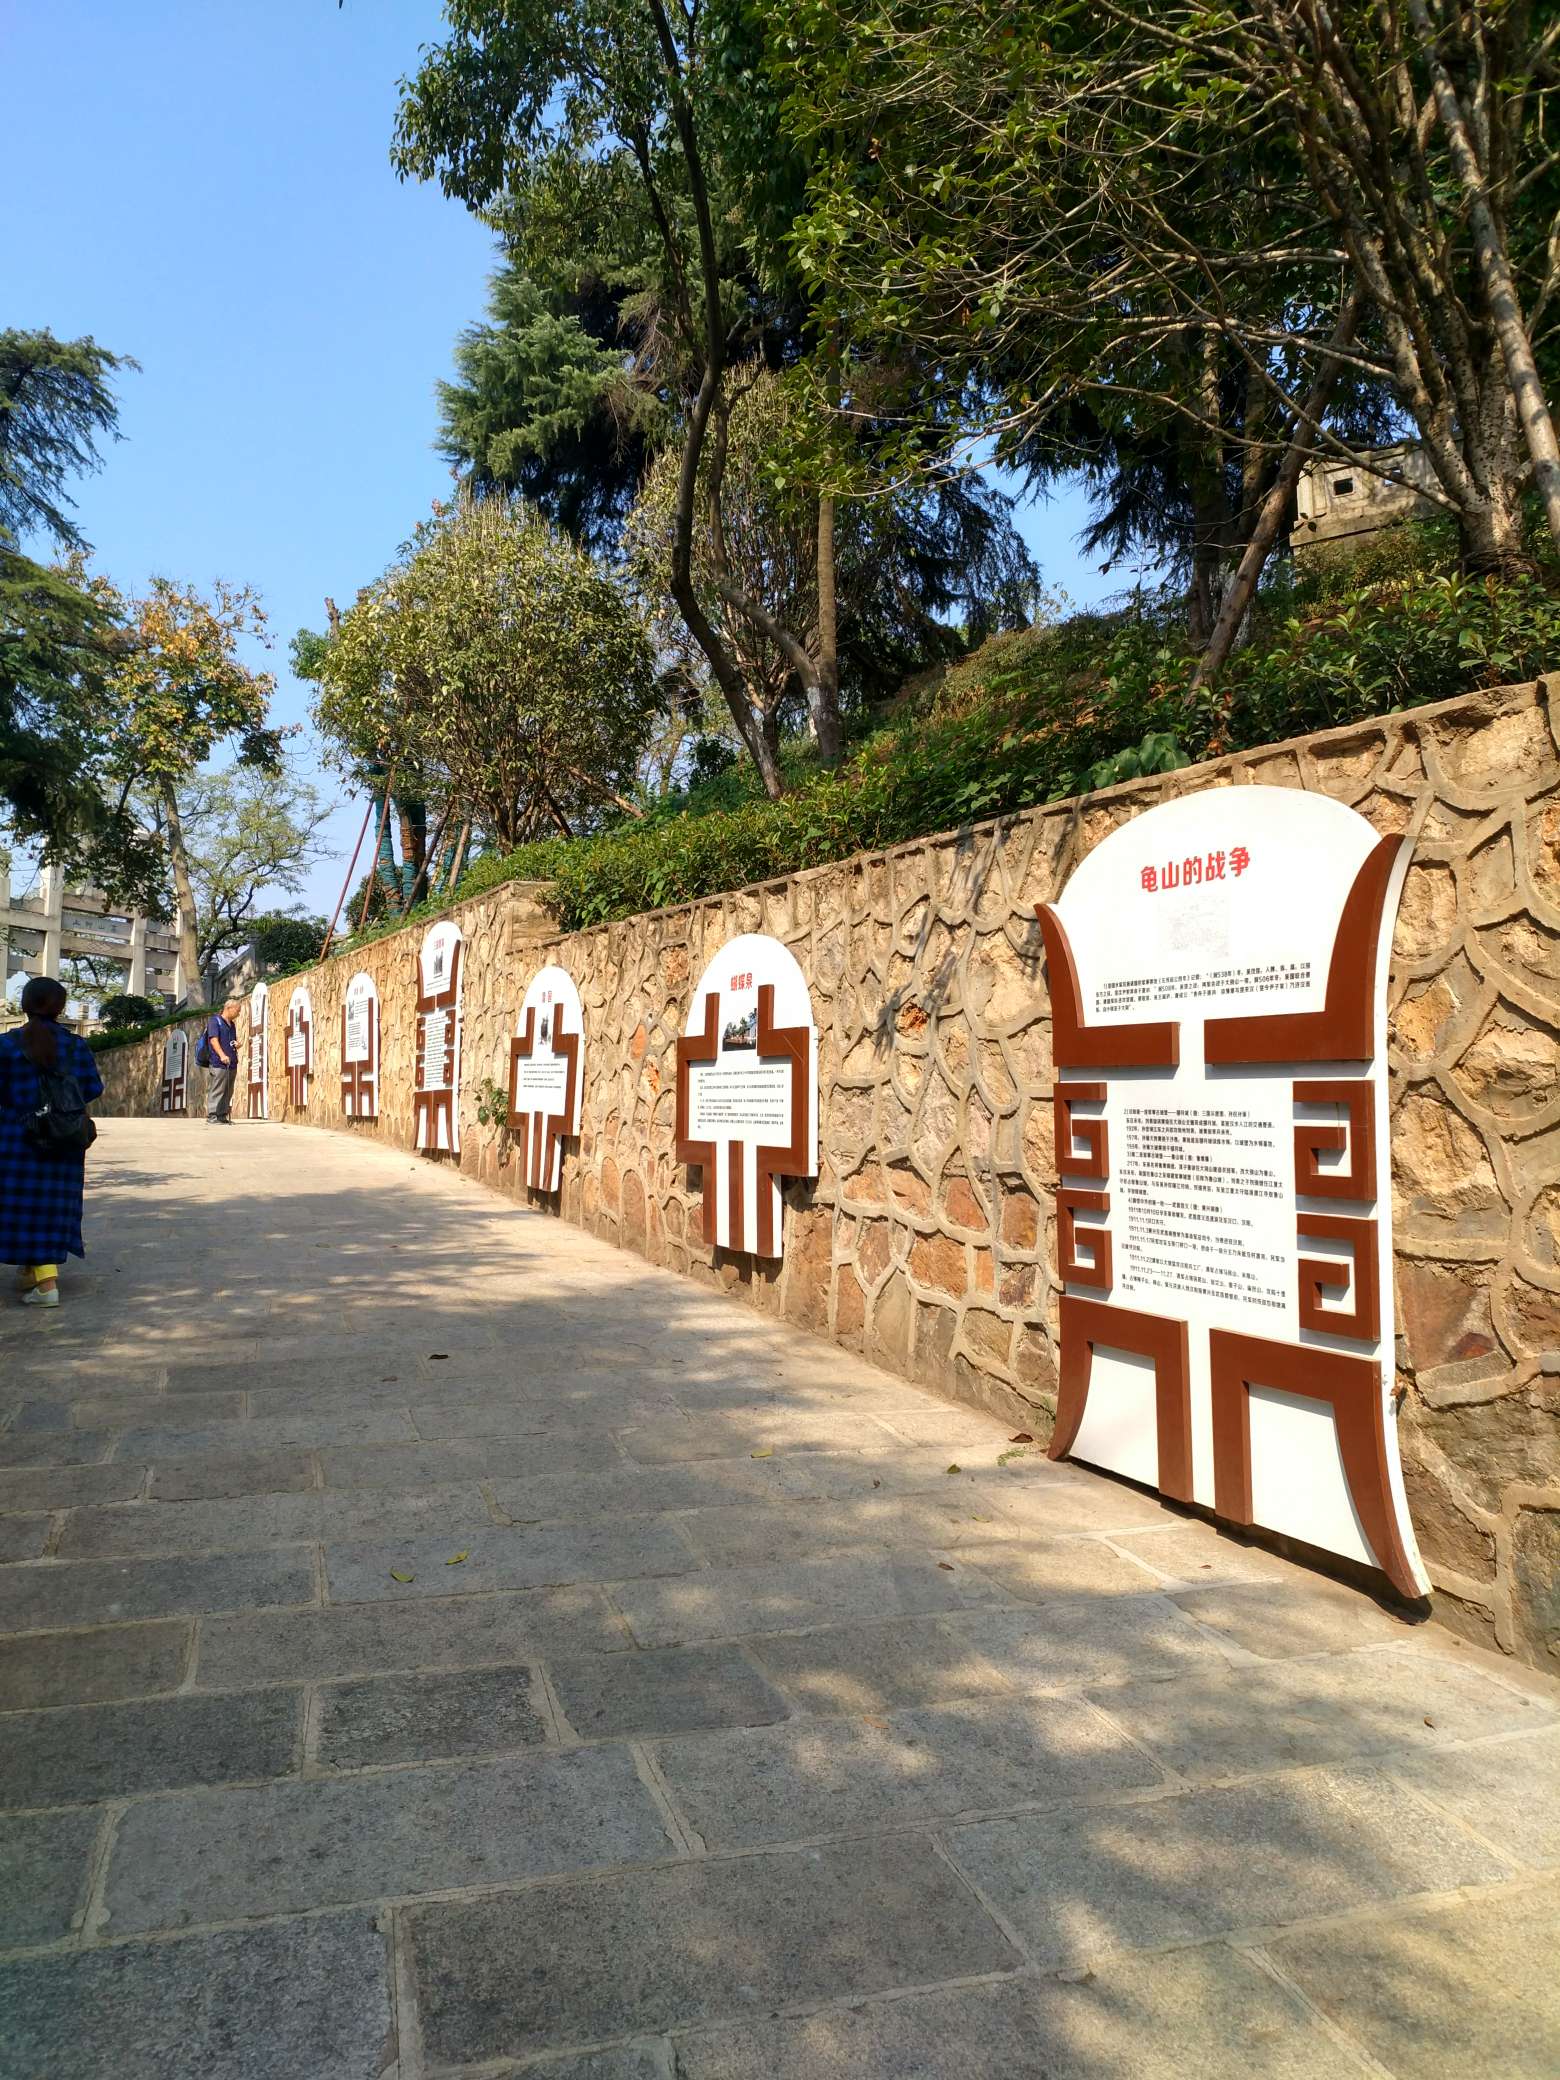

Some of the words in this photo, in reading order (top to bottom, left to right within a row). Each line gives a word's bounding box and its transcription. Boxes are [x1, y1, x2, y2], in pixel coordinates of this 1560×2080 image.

[1140, 846, 1251, 893] 龟山的战争
